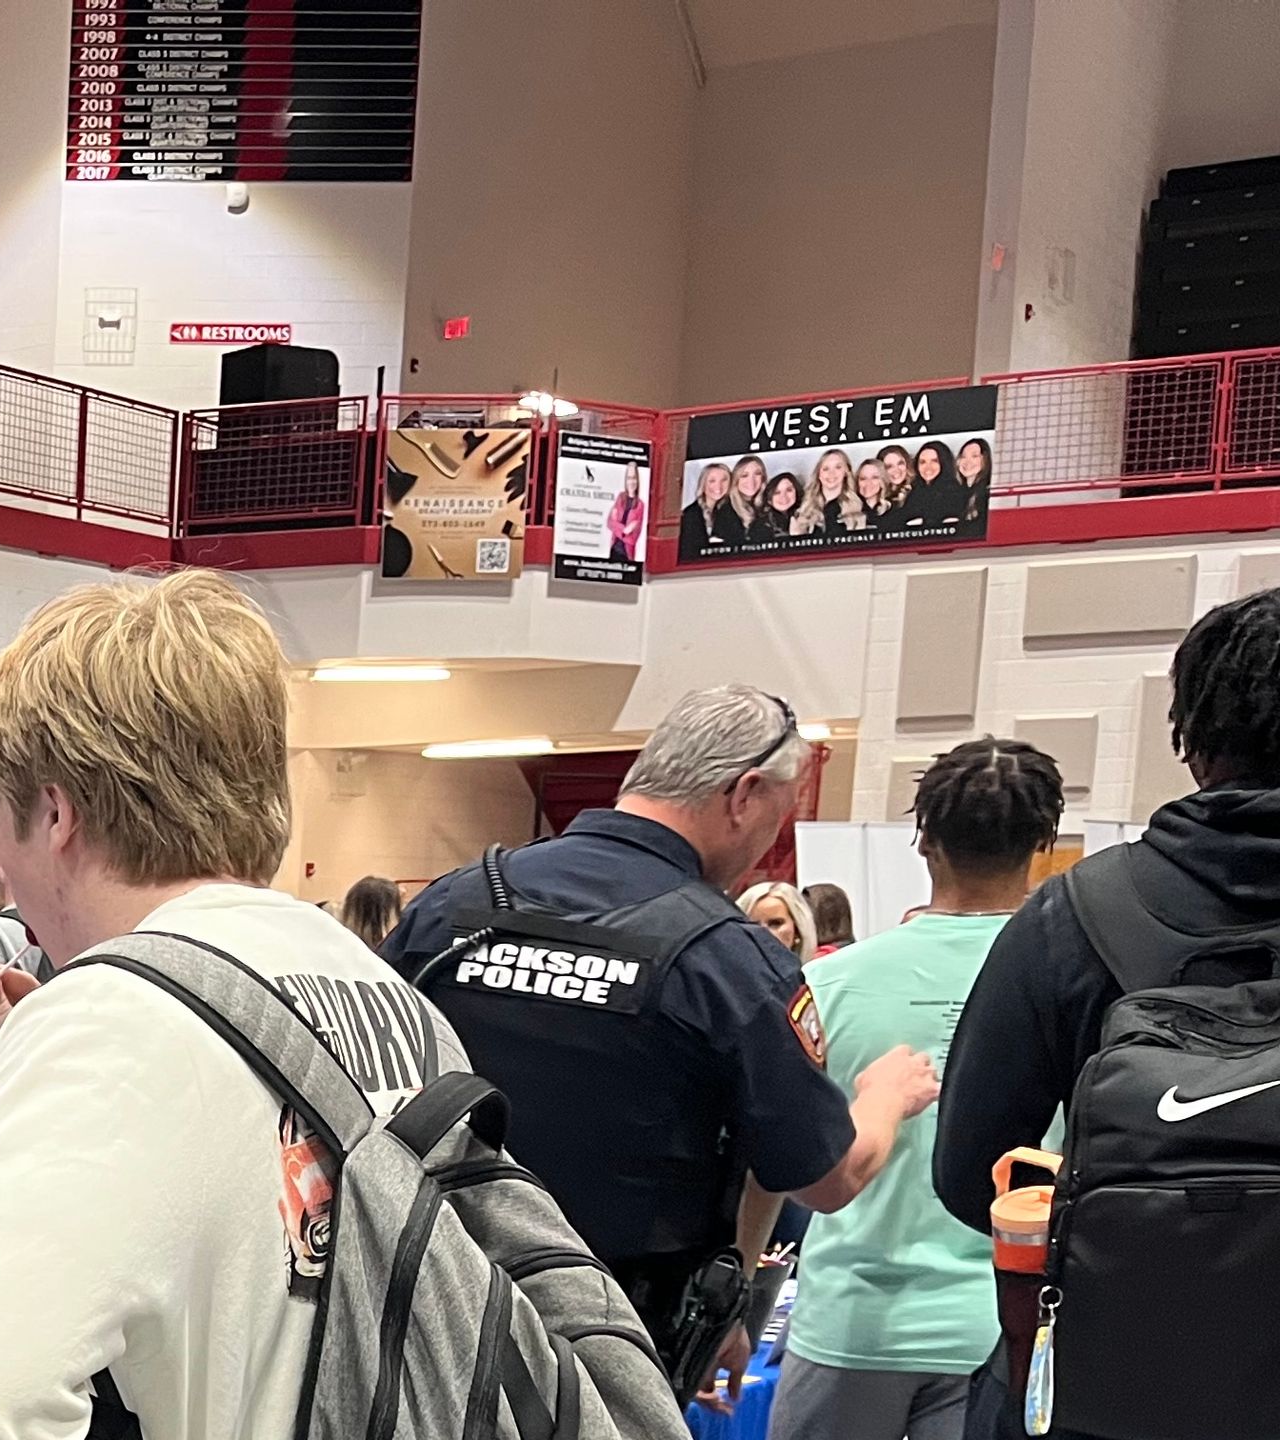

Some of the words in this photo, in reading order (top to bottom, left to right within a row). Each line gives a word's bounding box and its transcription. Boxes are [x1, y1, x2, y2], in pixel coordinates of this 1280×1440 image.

[85, 14, 117, 26] 1993
[83, 31, 117, 43] 1998
[79, 48, 119, 60] 2007
[79, 65, 119, 77] 2008
[80, 82, 116, 94] 2010
[80, 99, 113, 112] 2013
[79, 116, 113, 128] 2014
[77, 133, 112, 146] 2015
[76, 150, 112, 163] 2016
[76, 167, 110, 180] 2017
[201, 326, 290, 341] RESTROOMS
[749, 402, 854, 440] WEST
[874, 393, 931, 426] EM
[456, 961, 612, 1005] POLICE
